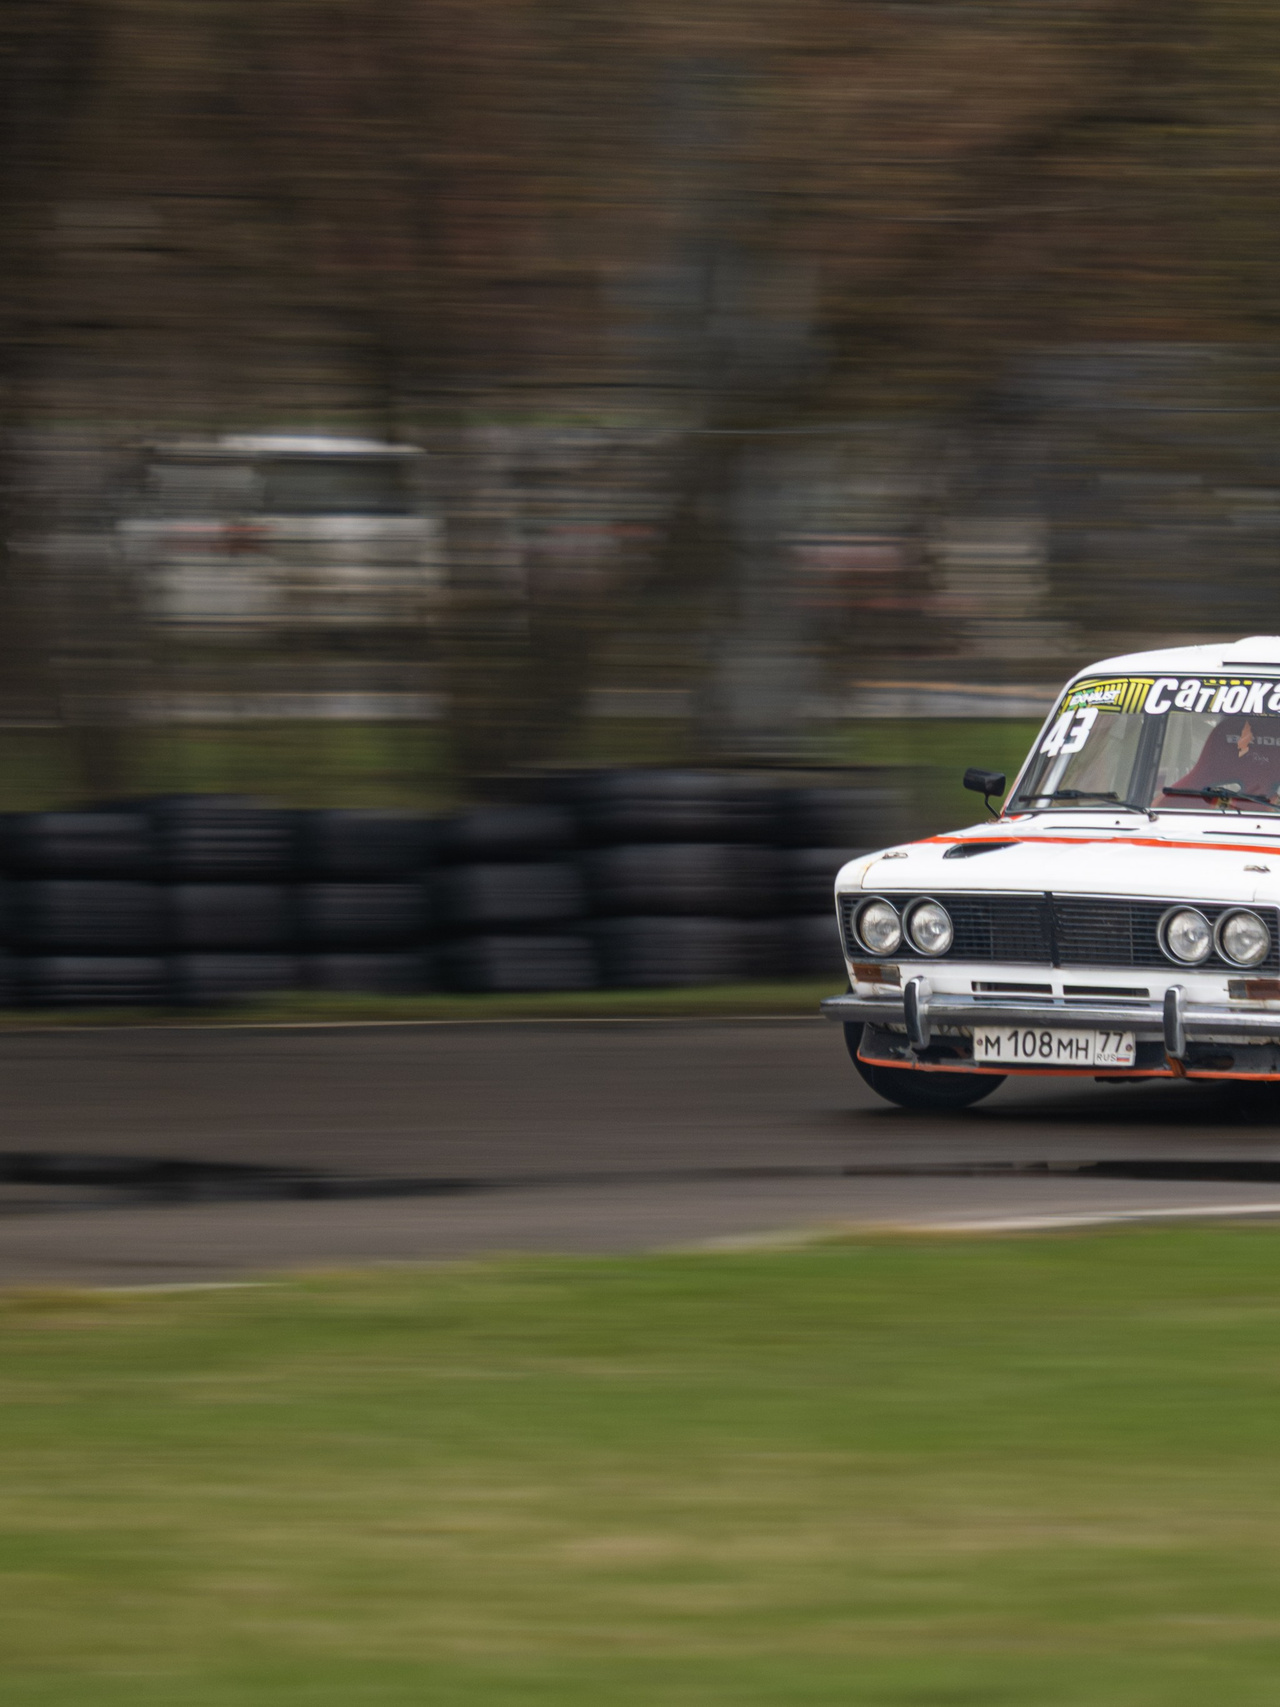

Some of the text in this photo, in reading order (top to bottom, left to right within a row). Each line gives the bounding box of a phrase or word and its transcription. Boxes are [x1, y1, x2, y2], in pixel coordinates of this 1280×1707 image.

[1040, 707, 1099, 757] 43
[1100, 1032, 1124, 1053] 77
[1096, 1053, 1117, 1062] RUS
